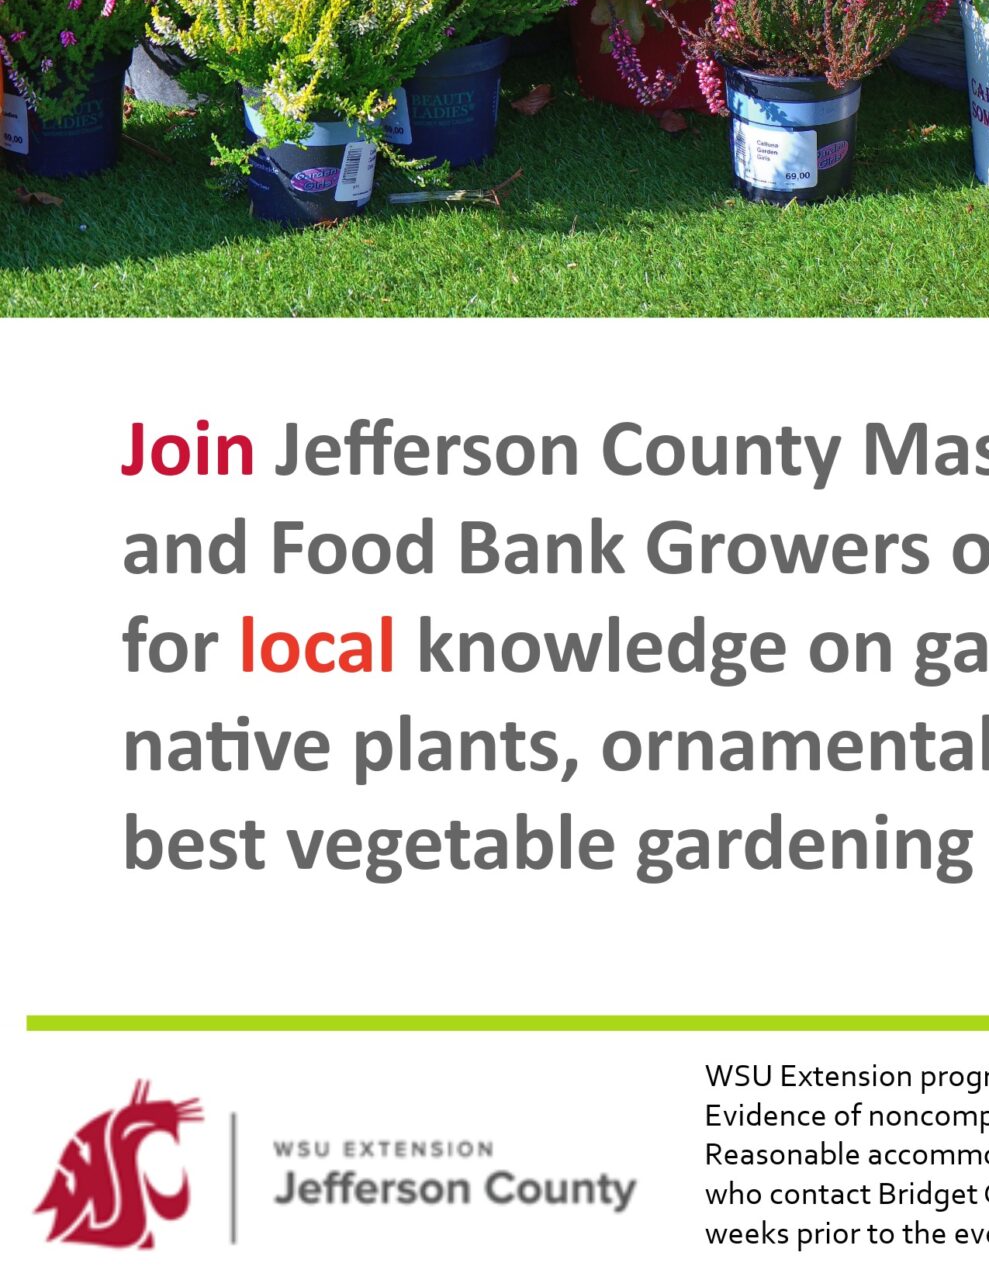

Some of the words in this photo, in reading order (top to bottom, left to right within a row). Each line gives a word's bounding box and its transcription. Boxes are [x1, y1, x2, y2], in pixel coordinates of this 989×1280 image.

[412, 91, 474, 106] BEAUTY
[756, 139, 779, 149] Calluna
[756, 148, 779, 156] Garden
[295, 169, 337, 181] Garden
[303, 179, 331, 191] Girls
[785, 172, 810, 181] 69,00
[121, 419, 252, 476] Join
[275, 418, 577, 476] Jefferson
[603, 422, 841, 490] County
[124, 517, 245, 574] and
[274, 517, 433, 574] Food
[462, 517, 625, 574] Bank
[647, 521, 929, 574] Growers
[122, 615, 218, 673] for
[243, 616, 392, 673] local
[420, 616, 786, 687] knowledge
[810, 632, 891, 673] on
[124, 714, 329, 771] native
[356, 714, 577, 785] plants,
[124, 813, 265, 870] best
[287, 813, 614, 884] vegetable
[637, 813, 973, 884] gardening
[706, 1065, 771, 1086] WSU
[782, 1064, 911, 1086] Extension
[707, 1102, 825, 1126] Evidence
[835, 1102, 862, 1126] of
[274, 1141, 330, 1158] WSU
[344, 1140, 493, 1158] EXTENSION
[707, 1141, 859, 1165] Reasonable
[274, 1170, 471, 1205] Jefferson
[485, 1170, 637, 1213] County
[706, 1181, 761, 1204] who
[771, 1185, 871, 1204] contact
[880, 1181, 977, 1212] Bridget
[706, 1220, 788, 1244] weeks
[798, 1222, 860, 1252] prior
[867, 1225, 894, 1244] to
[902, 1220, 945, 1244] the
